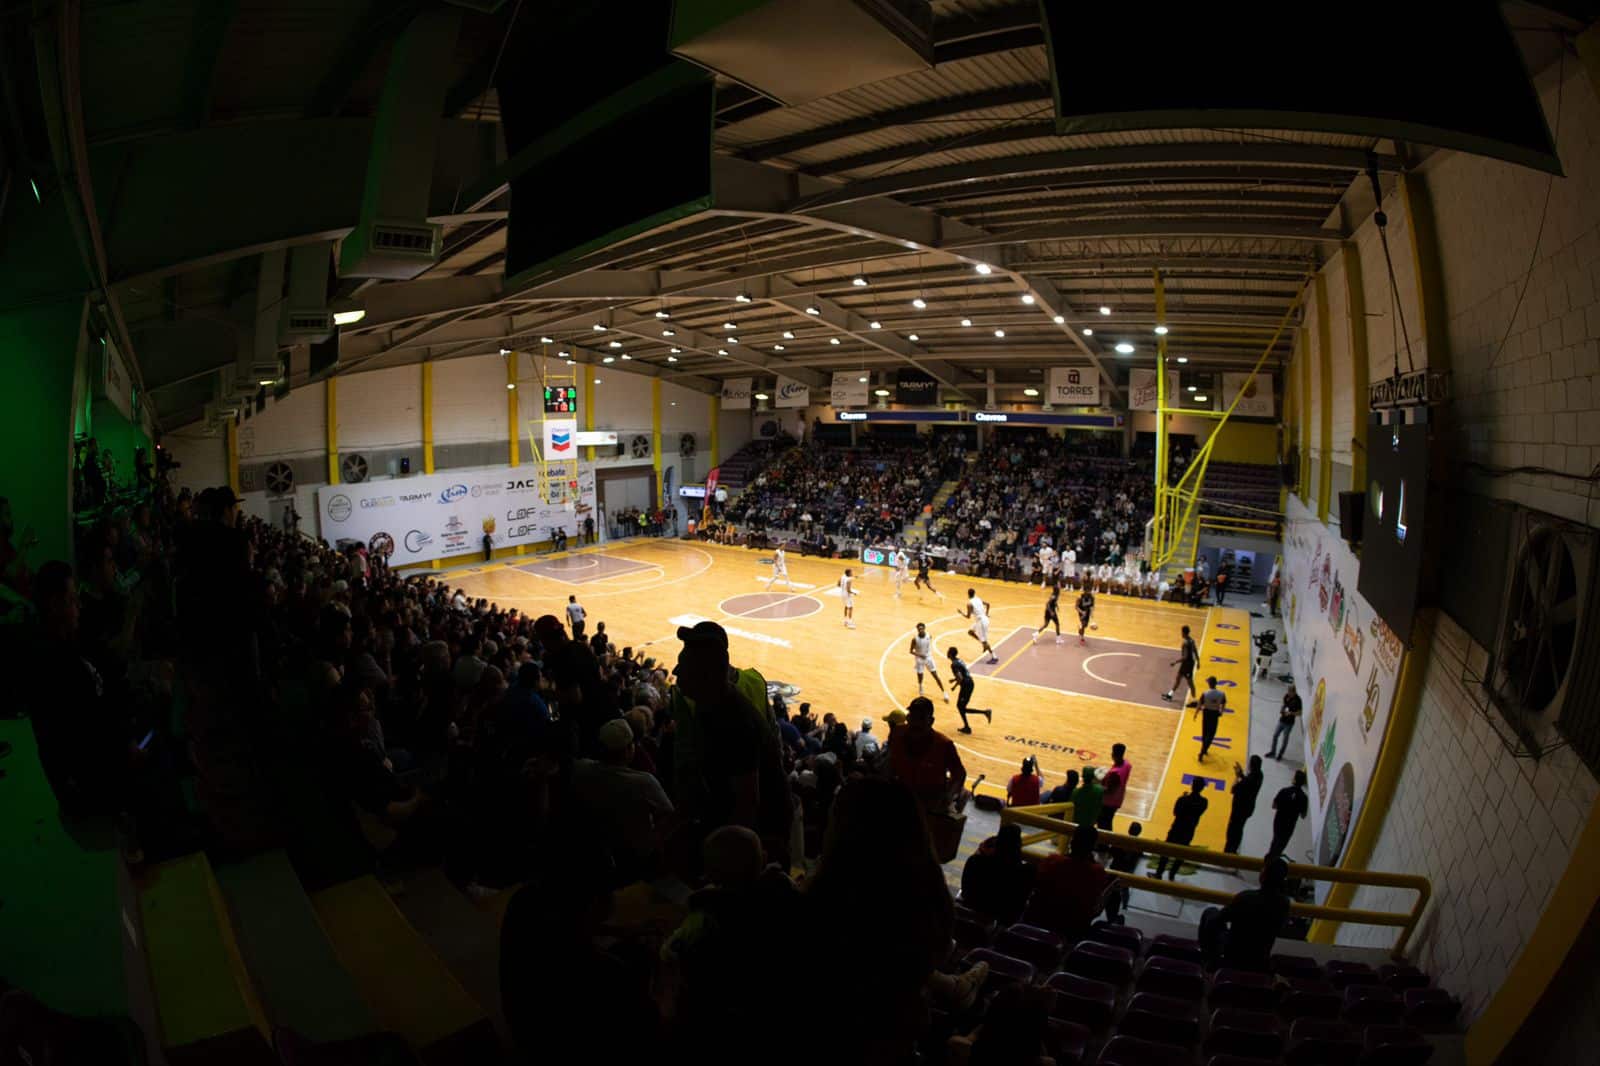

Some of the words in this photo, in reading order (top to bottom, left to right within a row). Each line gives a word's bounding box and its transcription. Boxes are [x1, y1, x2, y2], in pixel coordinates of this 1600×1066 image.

[1056, 386, 1094, 396] TORRES
[506, 479, 535, 490] JAC
[1181, 623, 1241, 791] GUASVE
